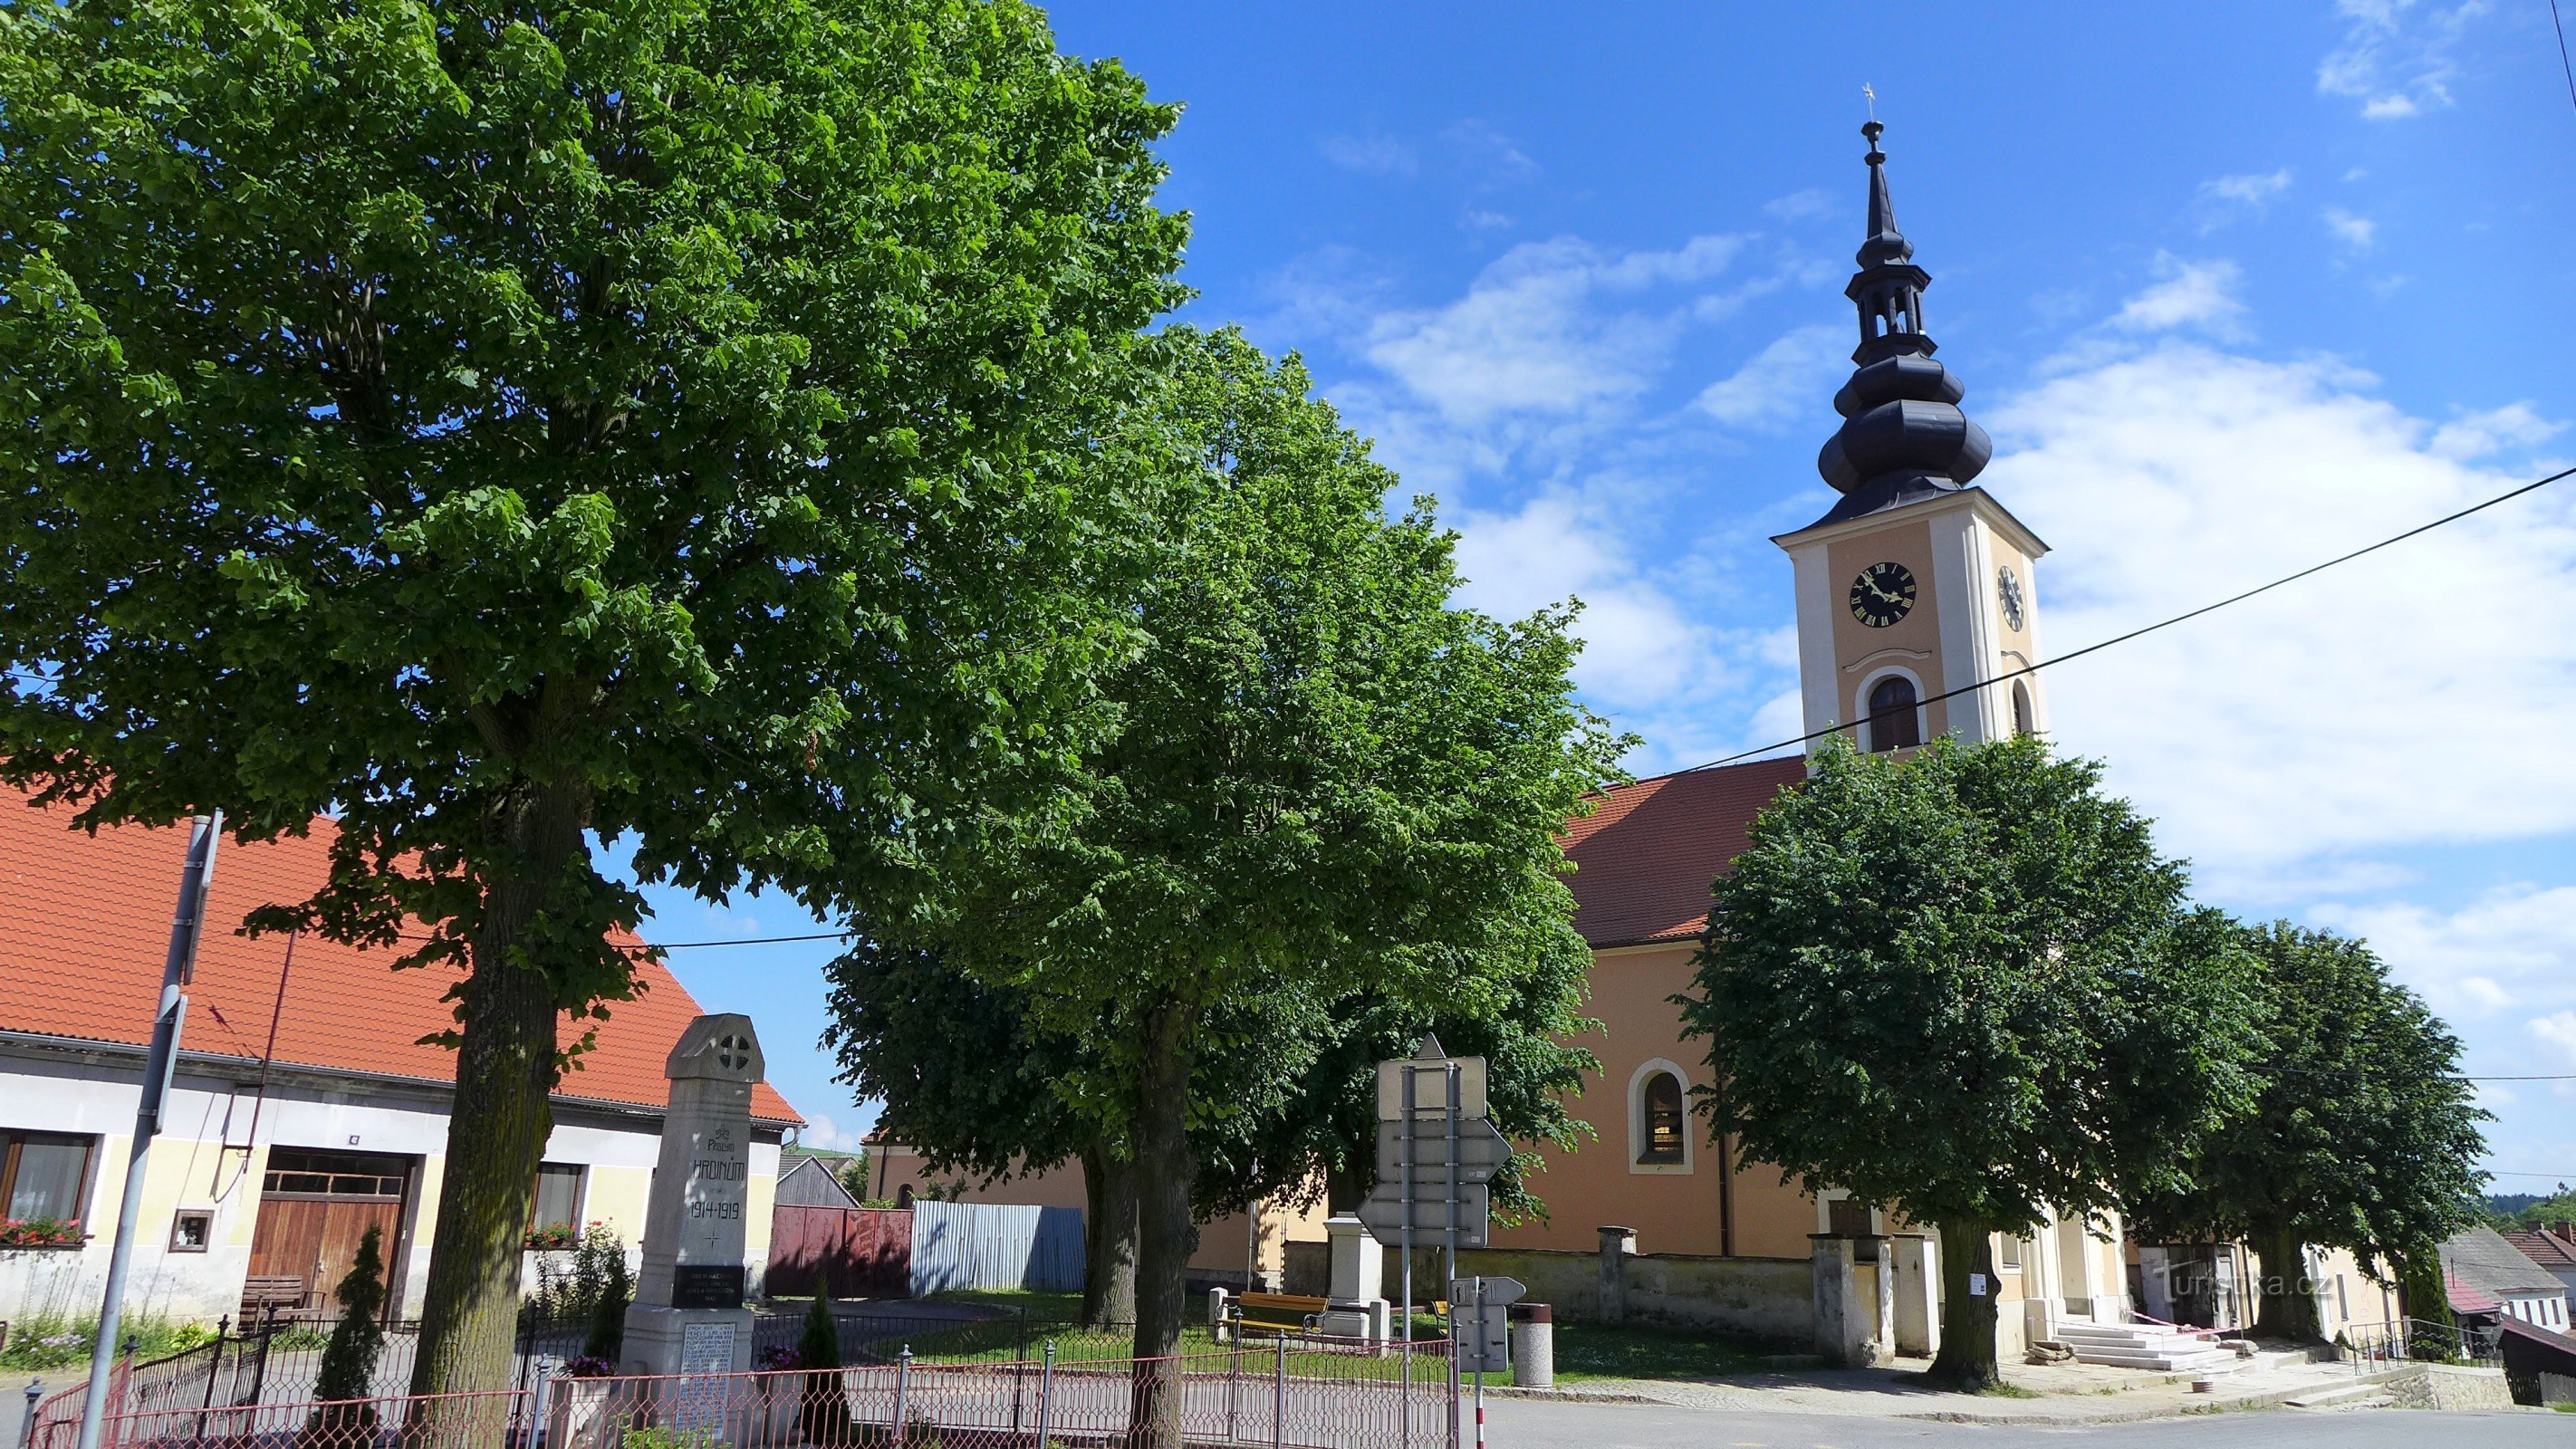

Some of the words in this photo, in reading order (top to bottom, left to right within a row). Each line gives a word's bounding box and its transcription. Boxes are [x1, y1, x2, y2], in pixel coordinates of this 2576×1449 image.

[1875, 563, 1886, 574] XII
[1891, 564, 1898, 574] I
[1899, 571, 1910, 581] II
[1853, 582, 1864, 590] X
[1904, 584, 1916, 593] III
[1854, 606, 1867, 620] VIII
[1894, 610, 1903, 620] V
[1865, 614, 1877, 627] VII
[1880, 616, 1889, 627] VI
[690, 1201, 740, 1220] 1914-1919
